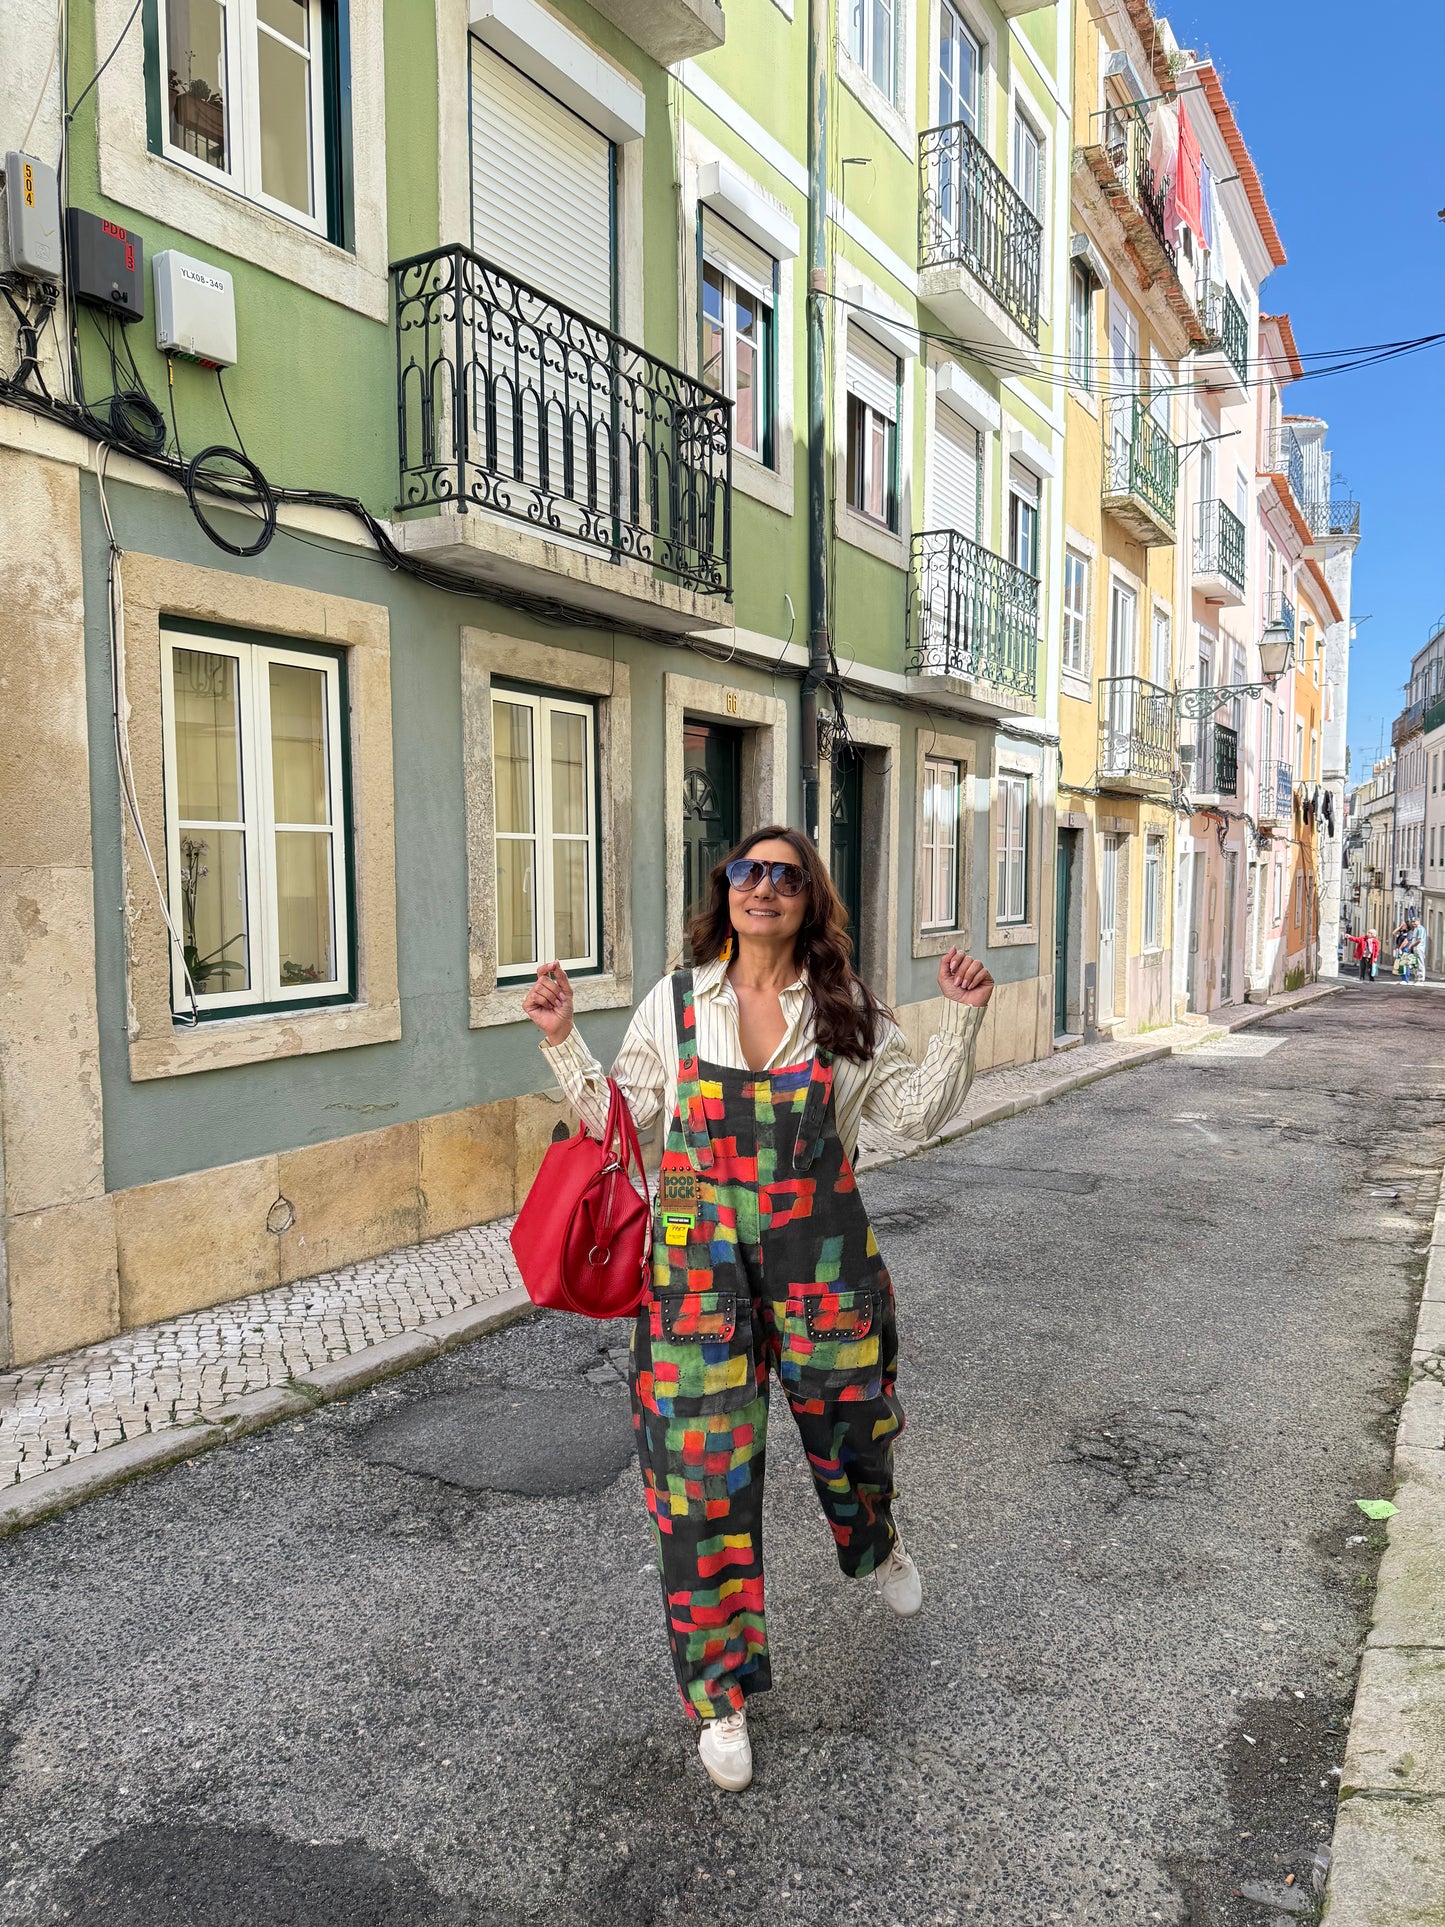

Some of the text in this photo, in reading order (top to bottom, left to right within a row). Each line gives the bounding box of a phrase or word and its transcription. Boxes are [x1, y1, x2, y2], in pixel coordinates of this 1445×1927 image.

[25, 164, 33, 206] 504
[127, 245, 134, 269] 13
[180, 267, 224, 291] YLX08-349
[726, 692, 738, 714] 66
